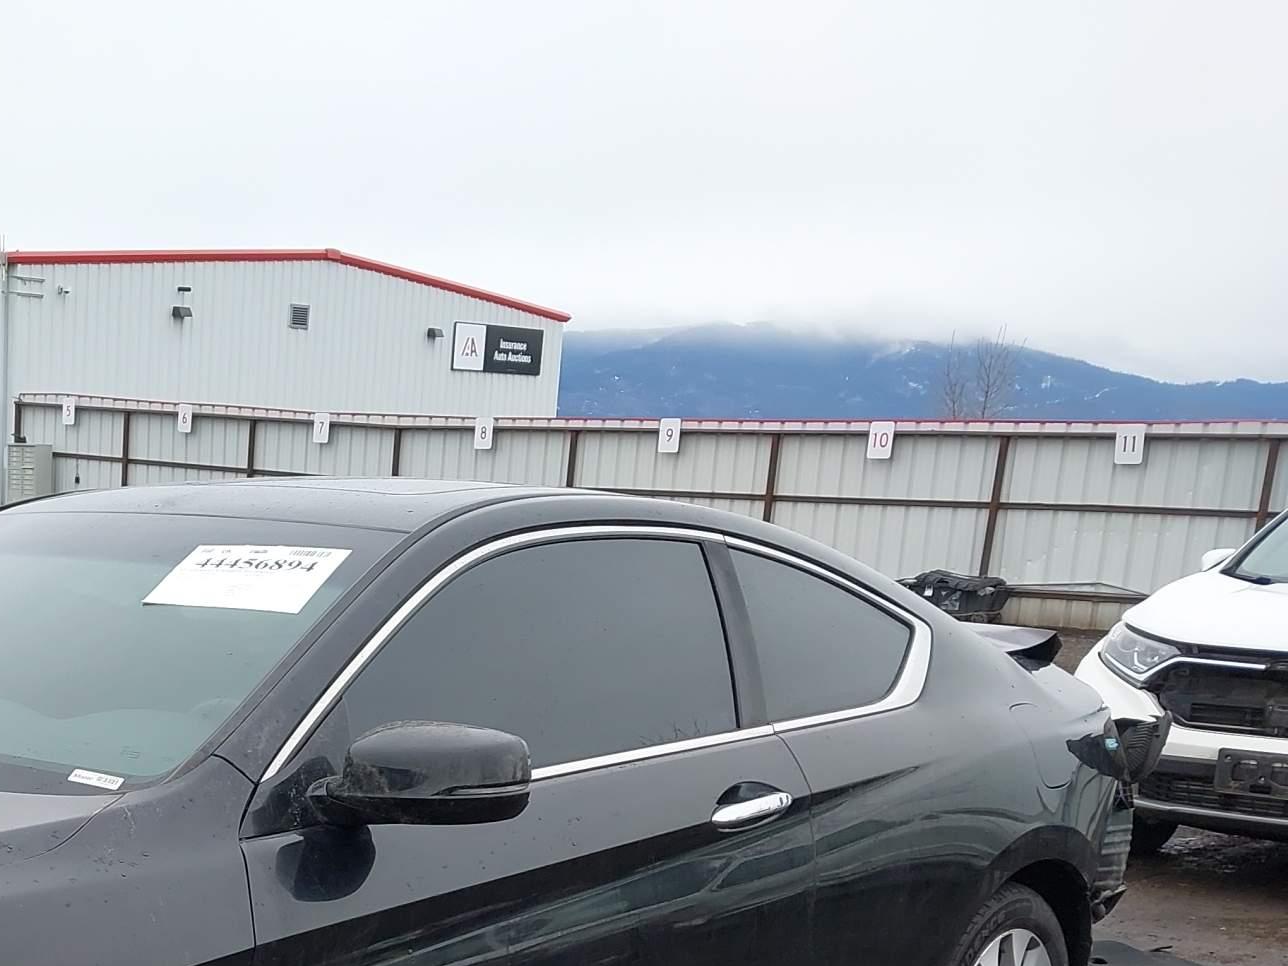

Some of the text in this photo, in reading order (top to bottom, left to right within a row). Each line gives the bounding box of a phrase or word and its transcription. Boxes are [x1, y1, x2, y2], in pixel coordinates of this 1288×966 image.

[499, 338, 527, 351] Insurance
[493, 350, 532, 363] Auto Auctions
[66, 405, 72, 417] 5
[182, 413, 187, 424] 6
[318, 421, 325, 434] 7
[480, 426, 487, 440] 8
[666, 428, 674, 442] 9
[873, 432, 889, 448] 10
[1122, 435, 1136, 453] 11
[196, 557, 318, 572] 44456894
